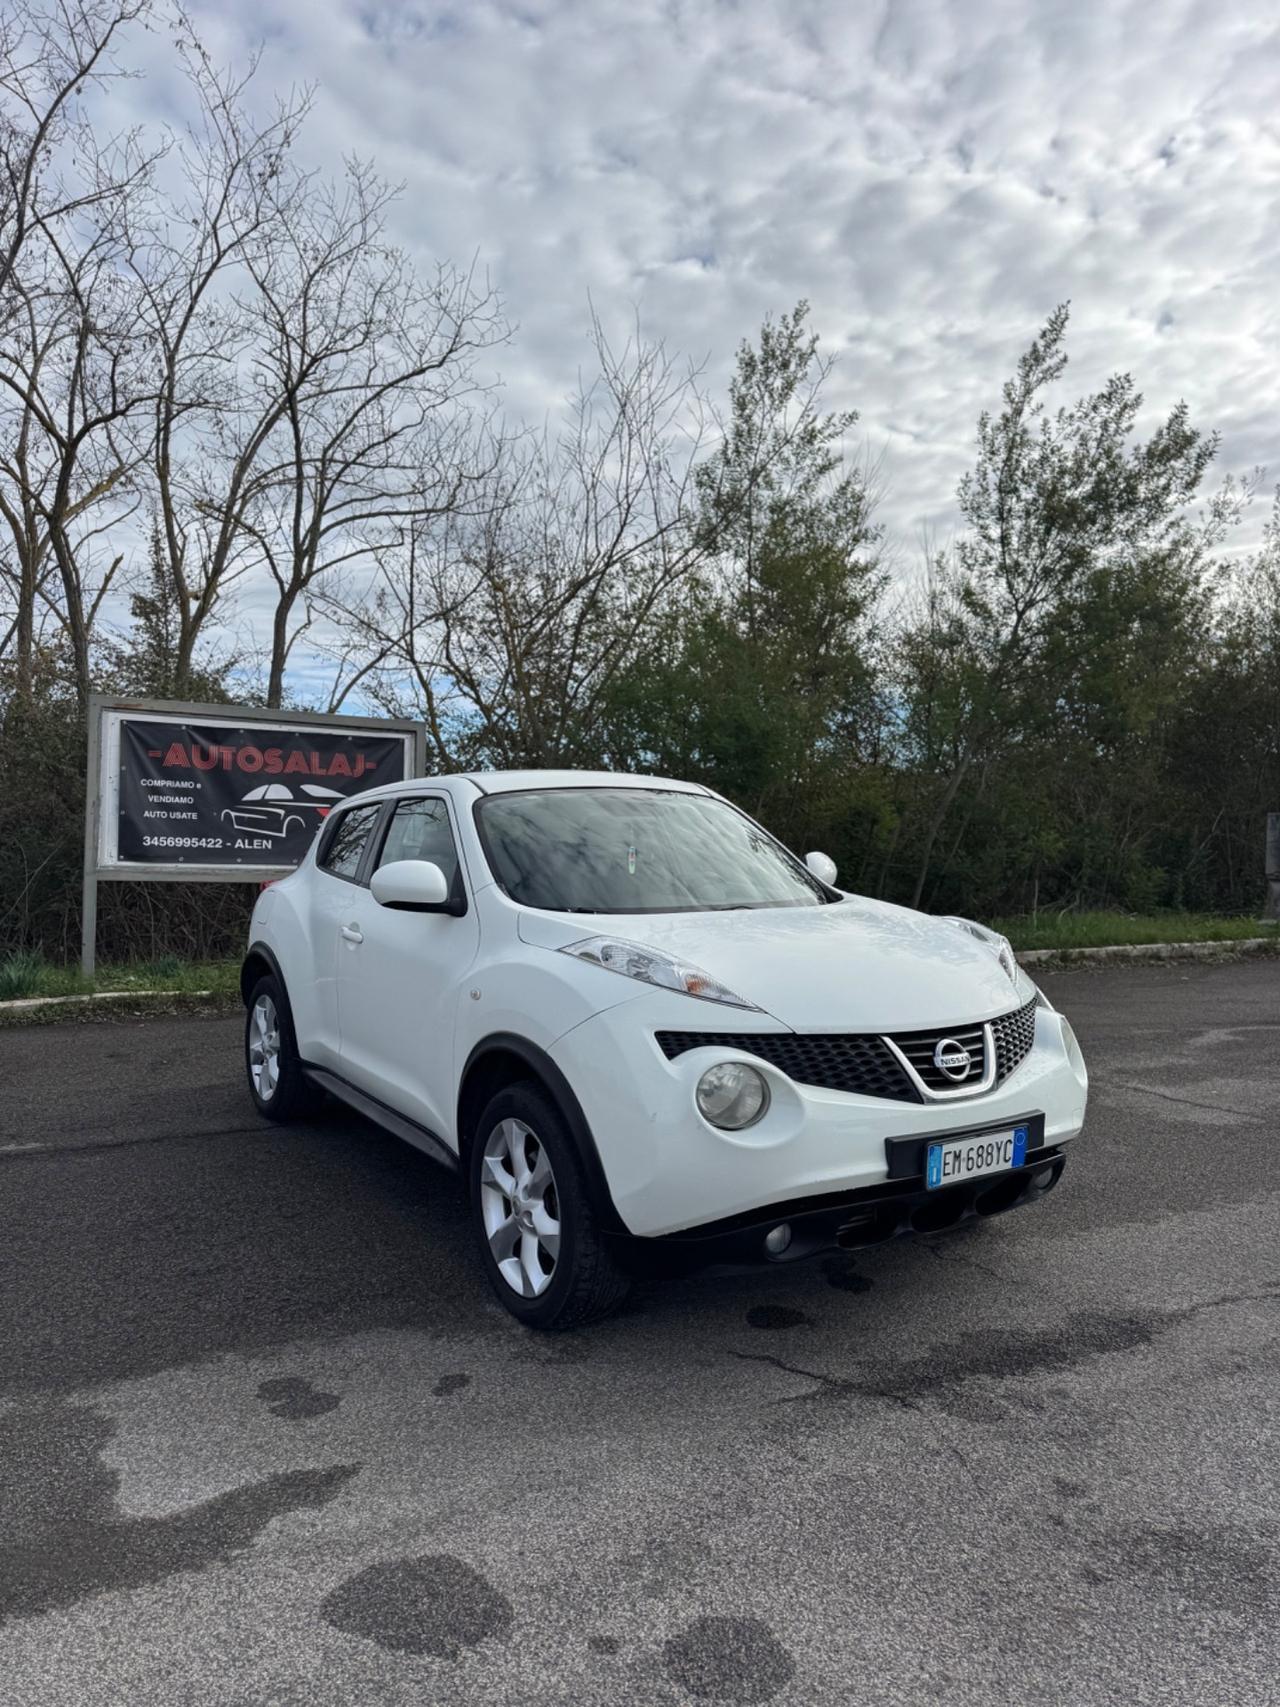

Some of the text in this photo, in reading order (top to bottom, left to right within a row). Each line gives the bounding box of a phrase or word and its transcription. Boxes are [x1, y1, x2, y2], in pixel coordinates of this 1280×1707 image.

[140, 778, 195, 789] COMPRIAMO
[147, 794, 194, 804] VENDIAMO
[143, 810, 198, 820] AUTO USATE
[142, 835, 223, 849] 3456995422
[234, 838, 273, 850] ALEN
[940, 1054, 970, 1066] NISSAN
